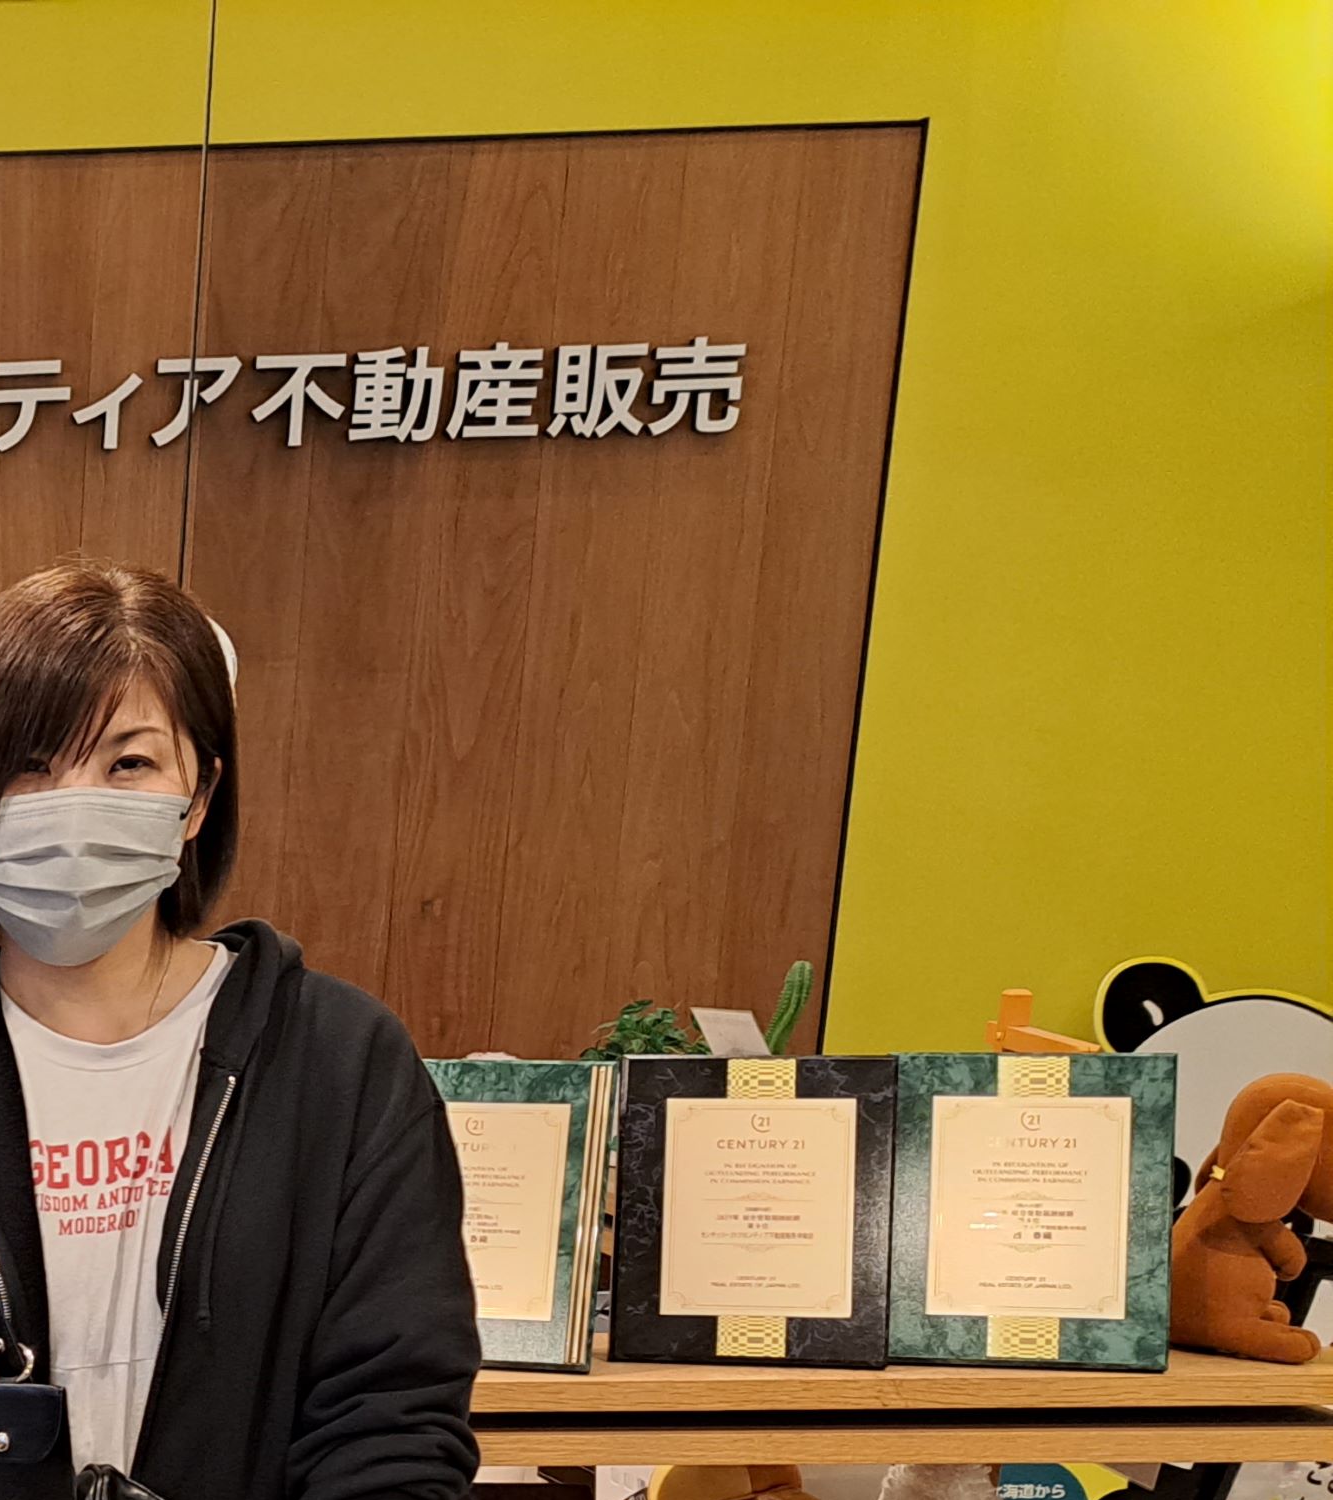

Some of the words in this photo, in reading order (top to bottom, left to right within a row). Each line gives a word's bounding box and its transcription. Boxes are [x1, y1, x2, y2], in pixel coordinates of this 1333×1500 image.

[717, 1139, 787, 1150] CENTURY
[793, 1140, 806, 1150] 21
[989, 1137, 1061, 1149] NTURY
[1064, 1138, 1077, 1149] 21
[30, 1126, 175, 1190] GEORGA
[36, 1193, 89, 1214] ISDOM
